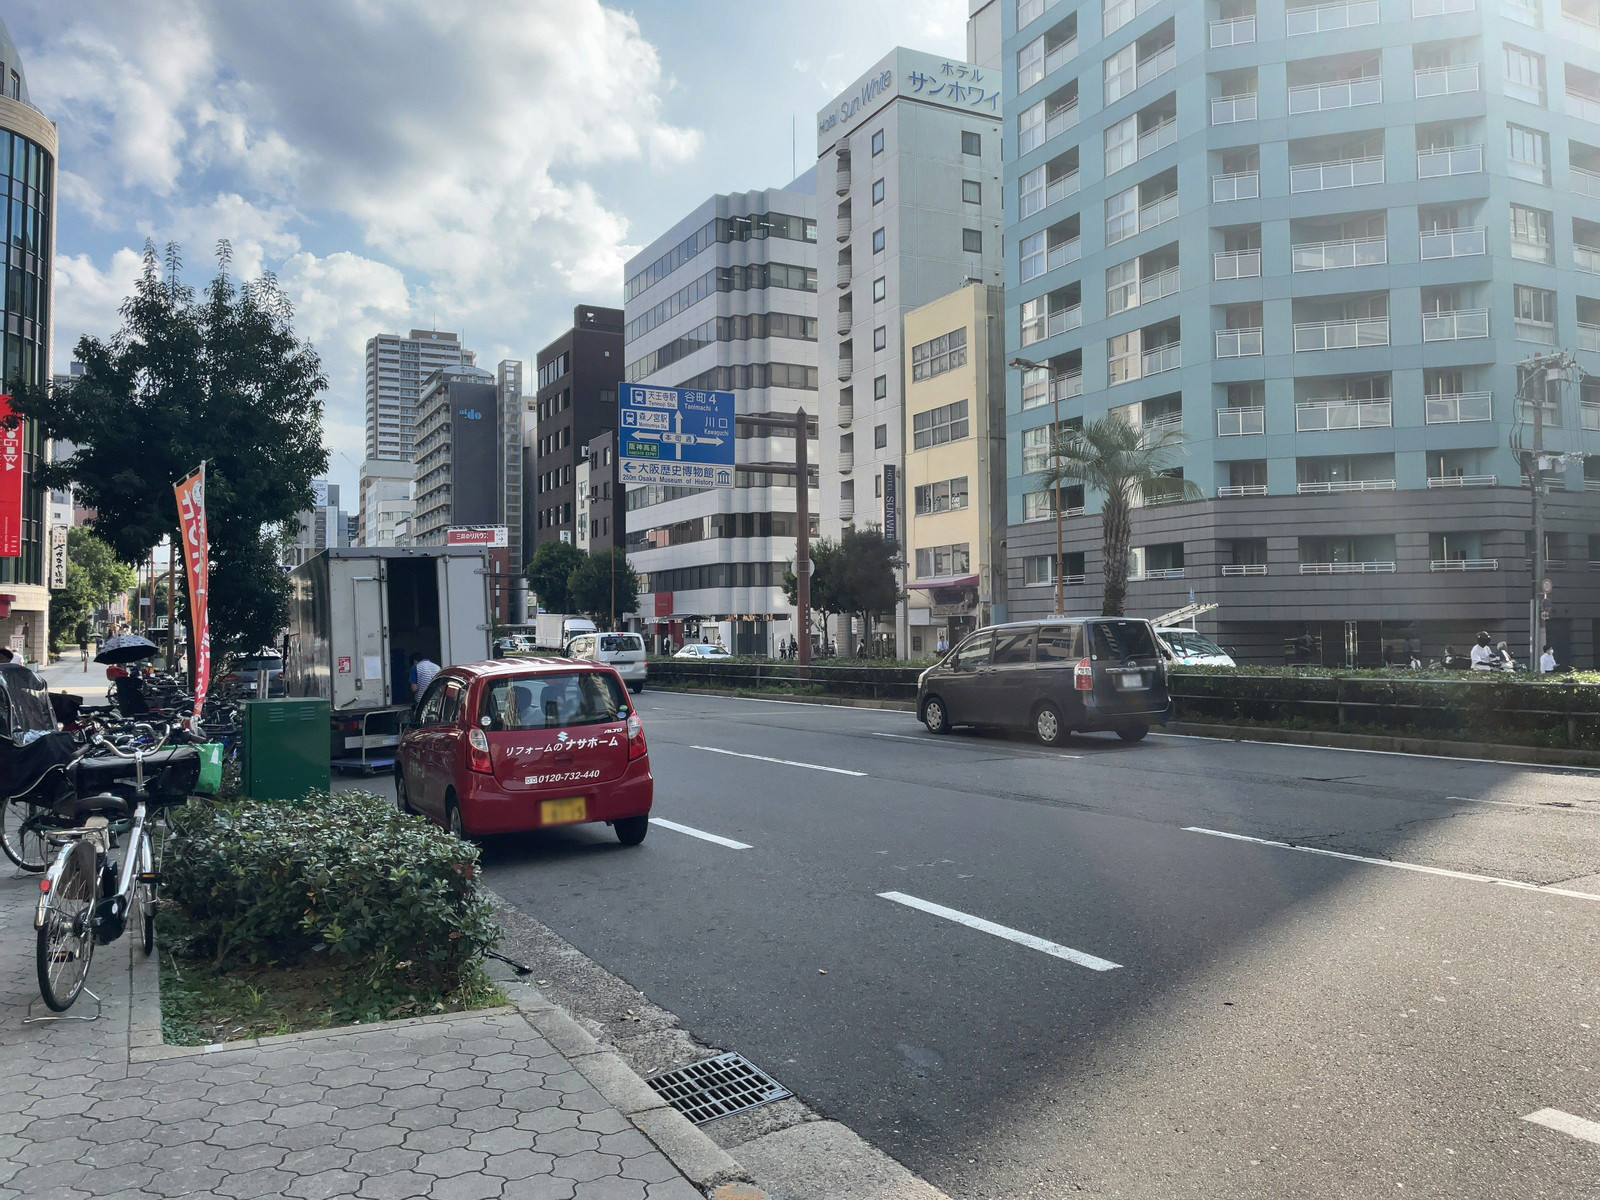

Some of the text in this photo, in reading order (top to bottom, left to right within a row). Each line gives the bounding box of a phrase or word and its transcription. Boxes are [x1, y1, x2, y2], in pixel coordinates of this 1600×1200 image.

[940, 61, 984, 83] ホテル
[818, 69, 892, 137] Hotel Sun White
[647, 390, 677, 402] 天王寺駅
[684, 403, 711, 412] Tanimachi
[638, 412, 668, 423] 森ノ宮駅
[704, 416, 728, 429] 川口
[664, 434, 693, 443] 本町通
[704, 429, 729, 437] Kawaguchi
[628, 442, 658, 452] 阪神高速
[638, 462, 714, 479] 大阪歴史博物館
[622, 473, 637, 481] 250m
[637, 474, 656, 483] Osaka
[659, 476, 683, 484] Museum
[694, 478, 714, 487] History
[538, 769, 600, 784] 0120-732-440
